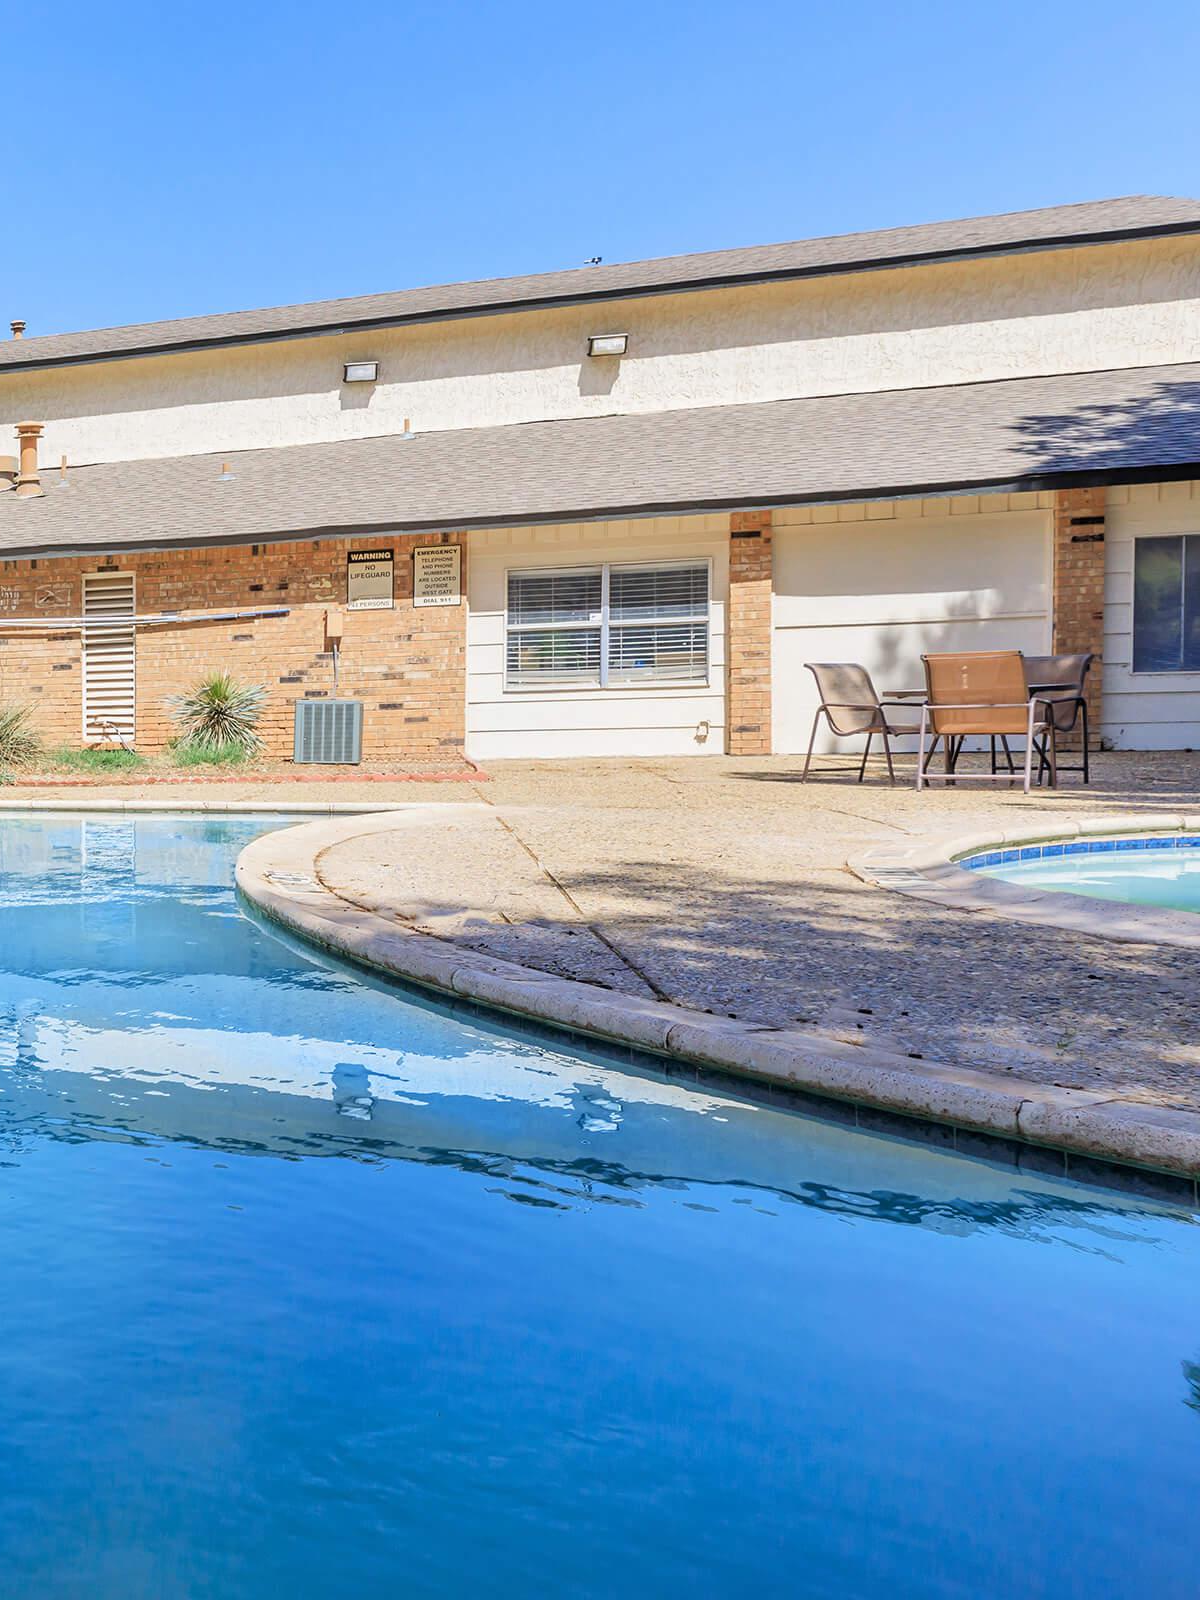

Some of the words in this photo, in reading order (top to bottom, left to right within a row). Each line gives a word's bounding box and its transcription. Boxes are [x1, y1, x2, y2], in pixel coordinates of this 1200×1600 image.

[351, 552, 391, 560] WARNING
[351, 571, 391, 579] LIFEGUARD
[359, 600, 390, 608] PERSONS
